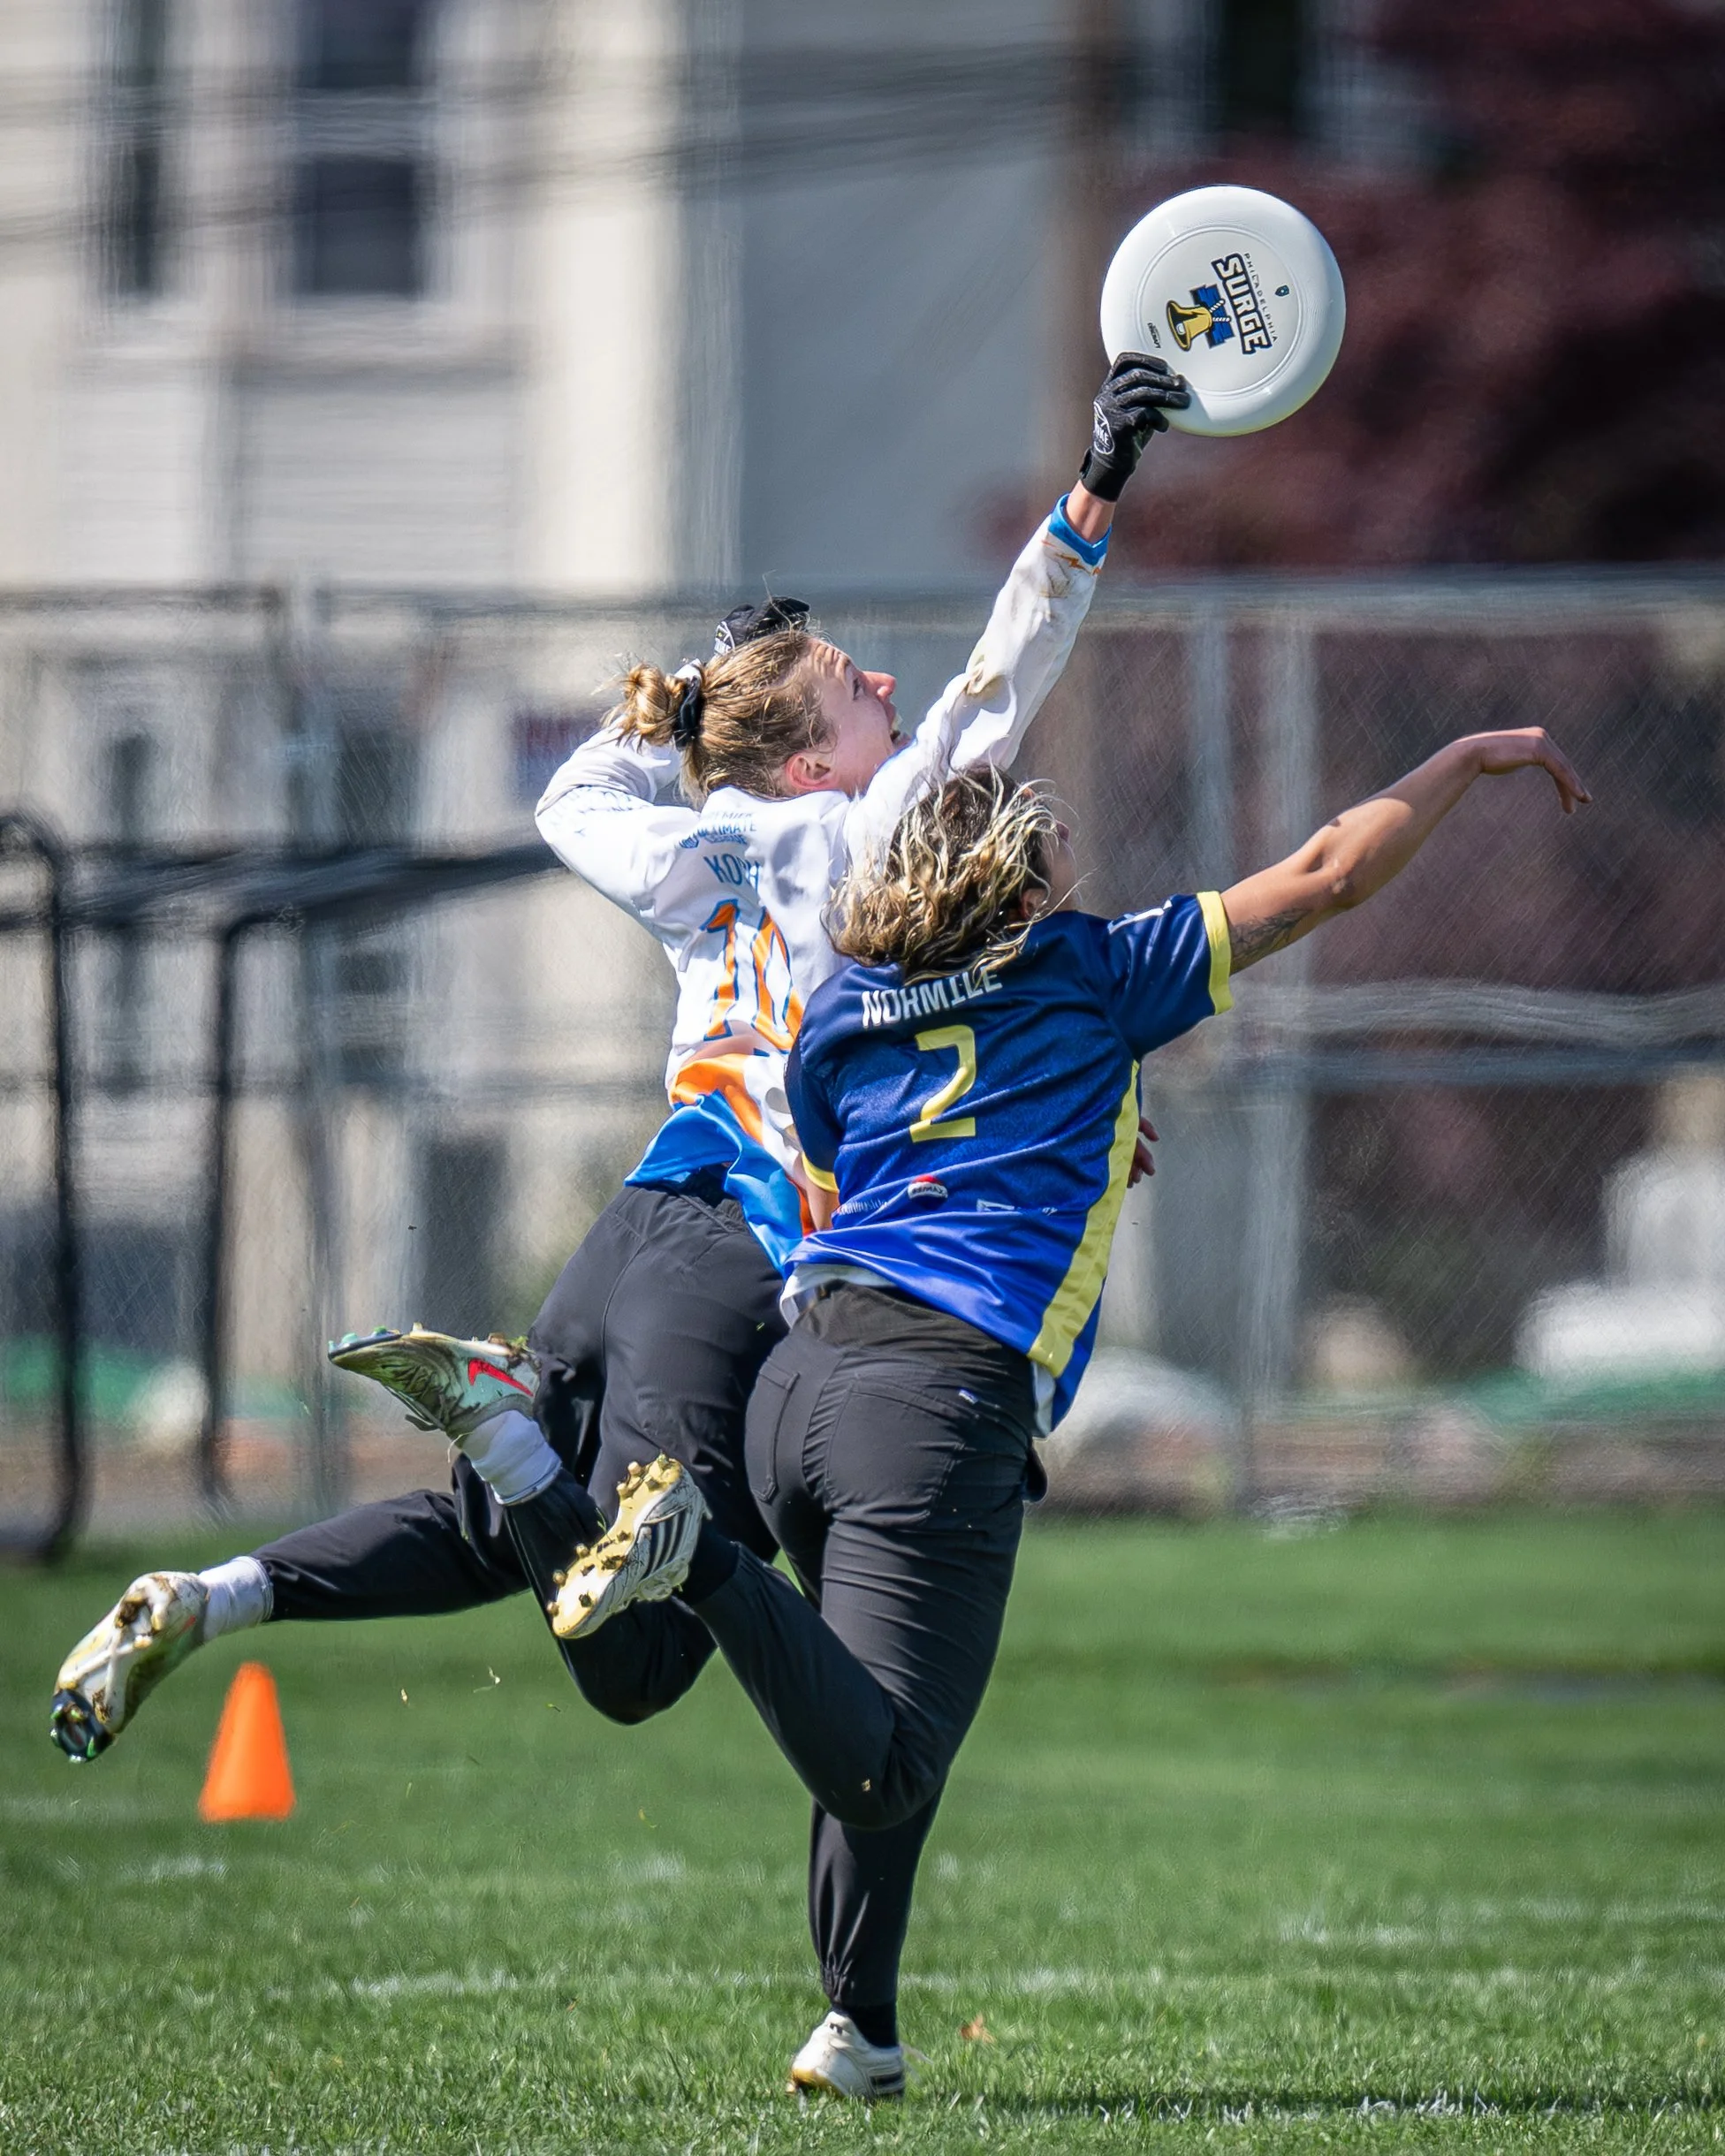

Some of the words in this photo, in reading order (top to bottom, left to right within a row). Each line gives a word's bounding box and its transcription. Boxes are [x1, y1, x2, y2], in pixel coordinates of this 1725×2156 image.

[1211, 253, 1273, 354] SURGE
[1244, 253, 1278, 342] PHILADELPHIA
[862, 966, 1003, 1029] NORMILE
[909, 1024, 976, 1143] 2
